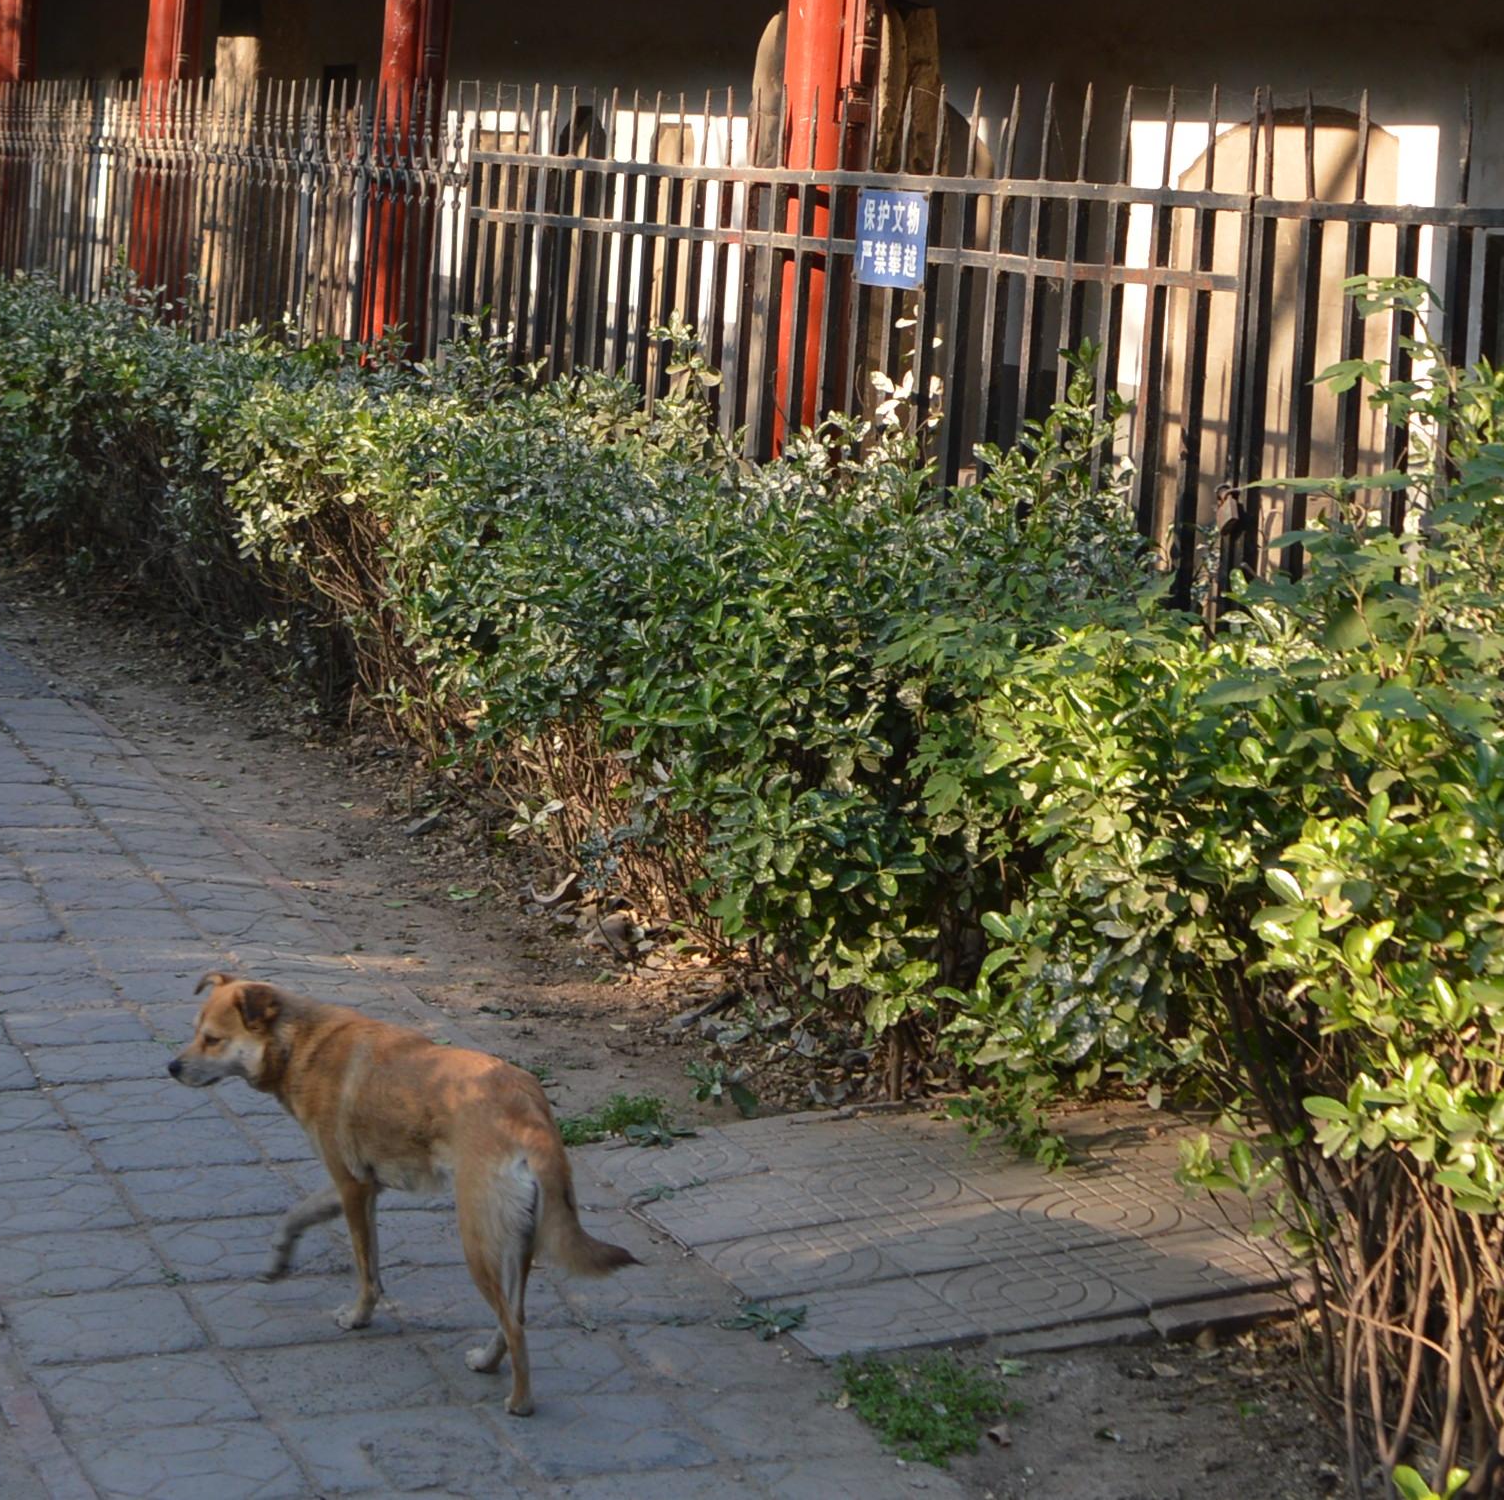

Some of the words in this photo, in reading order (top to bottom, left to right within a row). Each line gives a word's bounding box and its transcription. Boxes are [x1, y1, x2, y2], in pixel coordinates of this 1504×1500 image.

[864, 199, 920, 235] 保护文物
[860, 240, 917, 278] 严禁攀越
